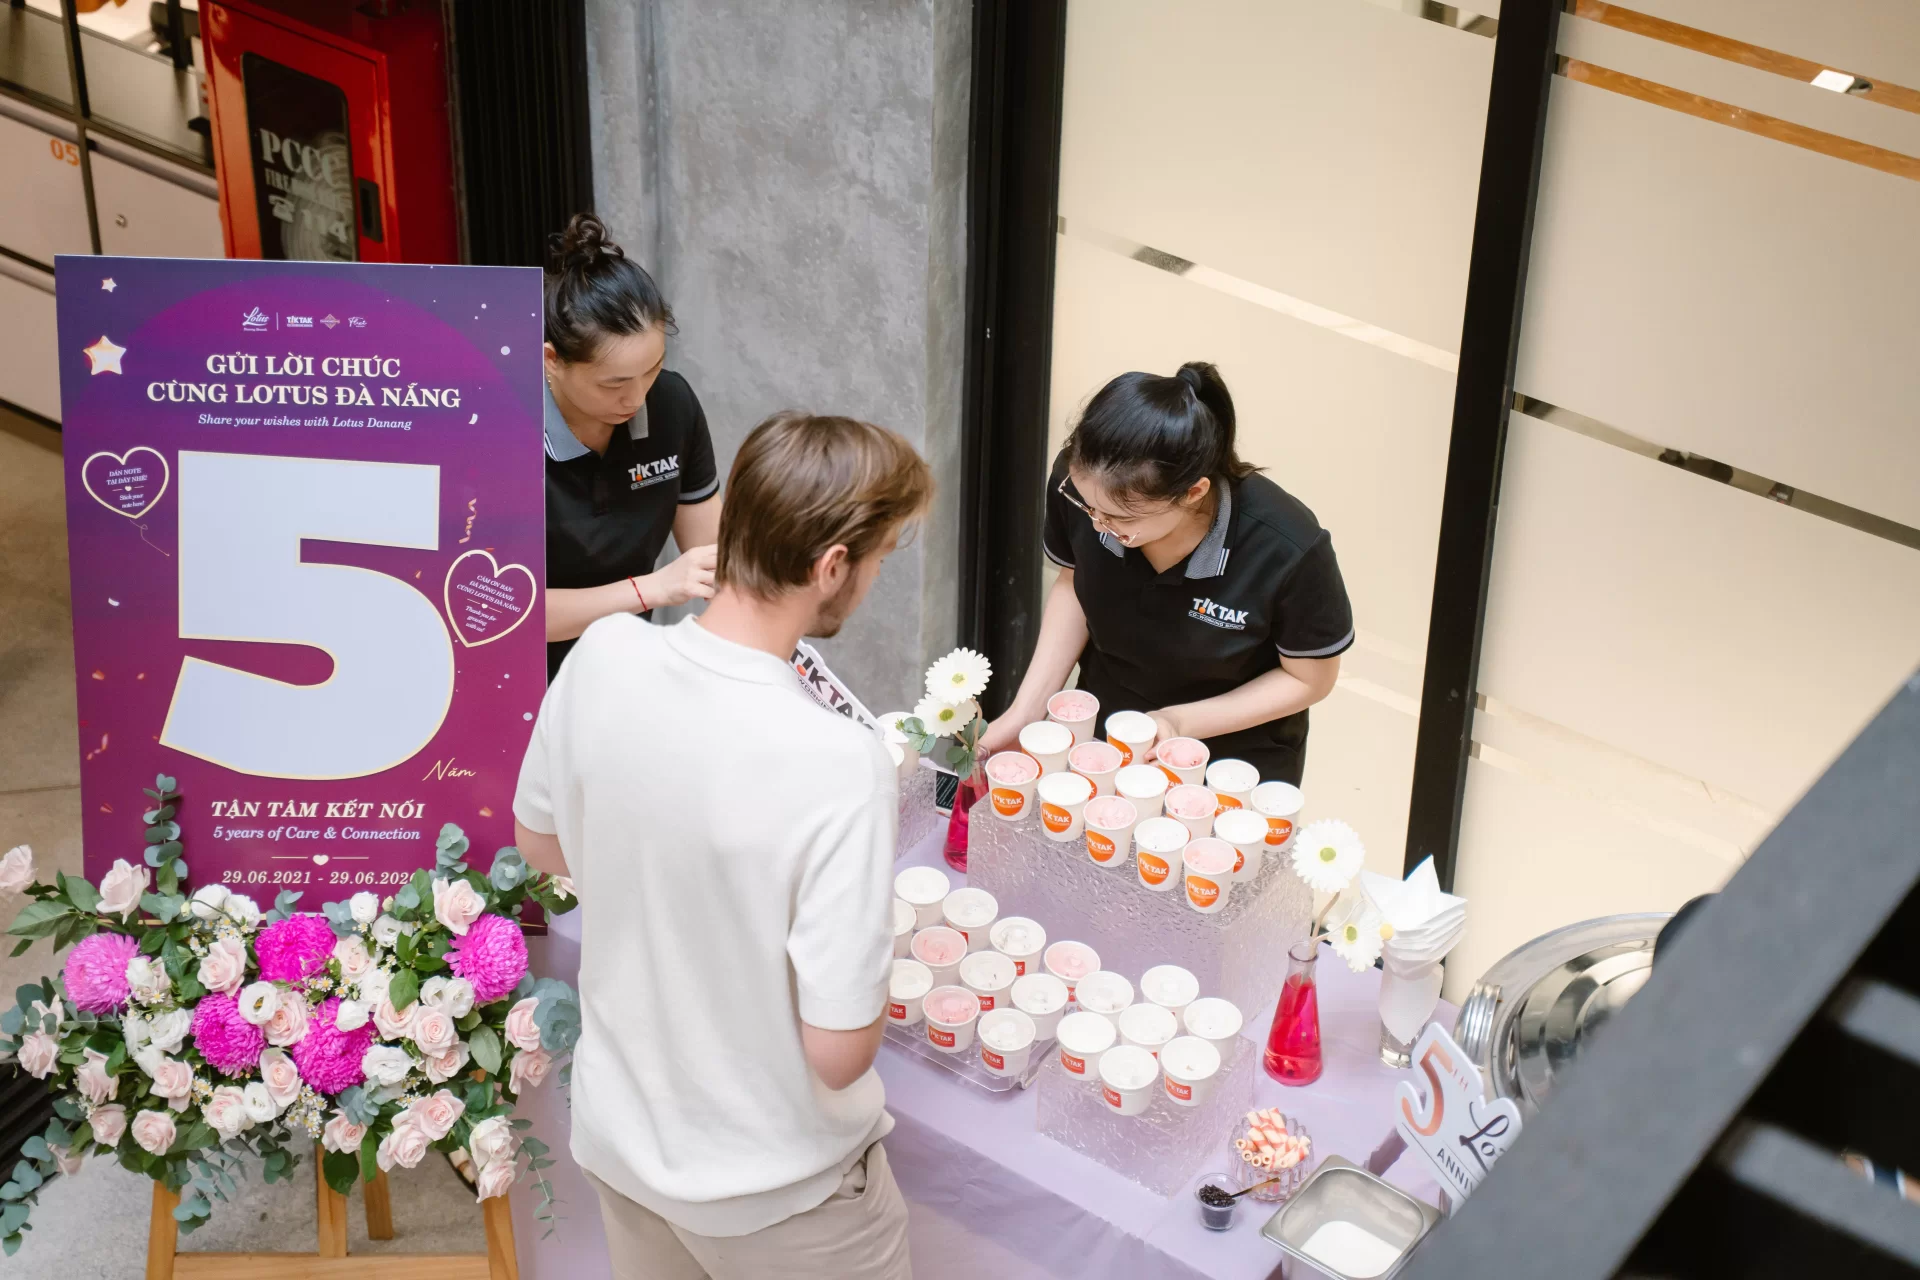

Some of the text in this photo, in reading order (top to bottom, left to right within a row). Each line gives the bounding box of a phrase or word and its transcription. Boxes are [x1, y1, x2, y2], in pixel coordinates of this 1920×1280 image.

[50, 137, 80, 167] 05
[242, 306, 270, 327] Lotus
[206, 351, 401, 378] GỬI LỜI CHÚC
[146, 379, 229, 403] CÙNG
[234, 384, 328, 405] LOTUS
[335, 382, 375, 406] ĐÀ
[198, 413, 413, 431] Share your wishes with Lotus Danang
[159, 450, 455, 780] 5
[422, 757, 476, 781] Năm
[211, 798, 426, 819] TẬN TÂM KẾT NỐI
[213, 825, 421, 842] 5 years of Care & Connection
[221, 870, 311, 884] 29.06.2021
[1459, 1101, 1509, 1173] Lo
